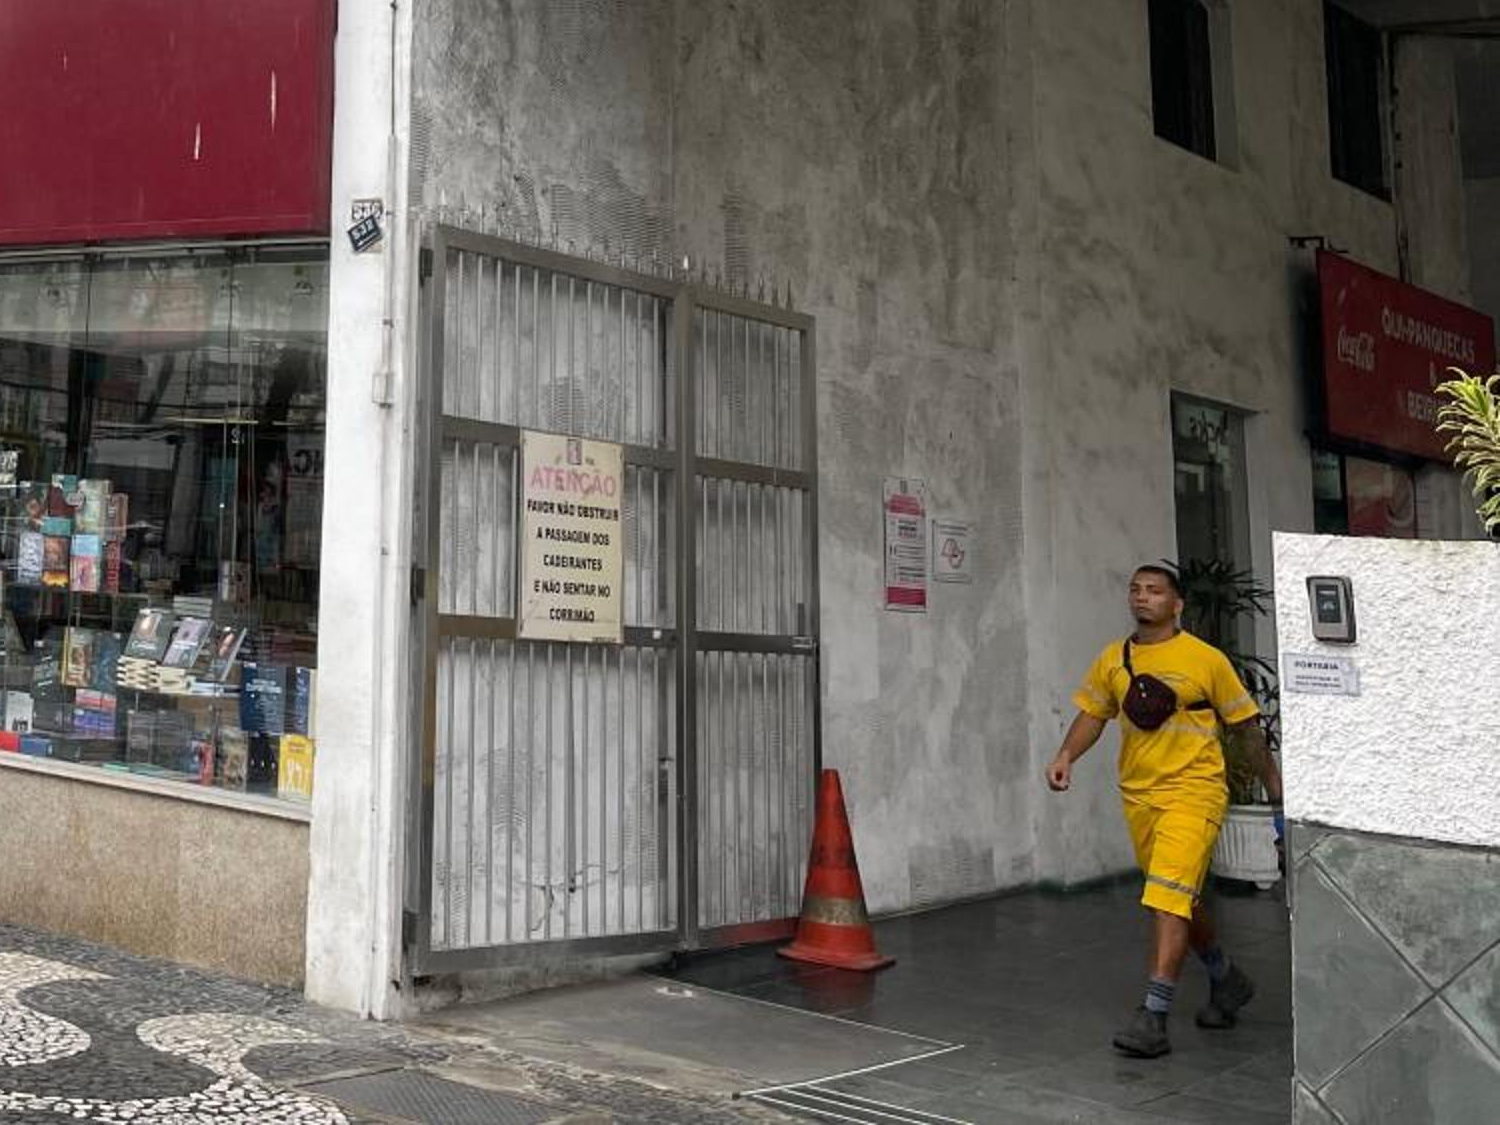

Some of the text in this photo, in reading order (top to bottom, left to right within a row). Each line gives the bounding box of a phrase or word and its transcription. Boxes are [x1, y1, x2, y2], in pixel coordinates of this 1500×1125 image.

[531, 466, 616, 499] ATENÇÃO
[527, 498, 555, 516] FAVOR
[557, 501, 575, 517] NÃO
[536, 526, 611, 546] A PASSAGEM DOS
[543, 554, 603, 572] CADEIRANTES
[534, 580, 540, 593] E
[542, 579, 561, 595] NÃO
[597, 584, 611, 598] NO
[549, 607, 596, 623] CORRIMÃO
